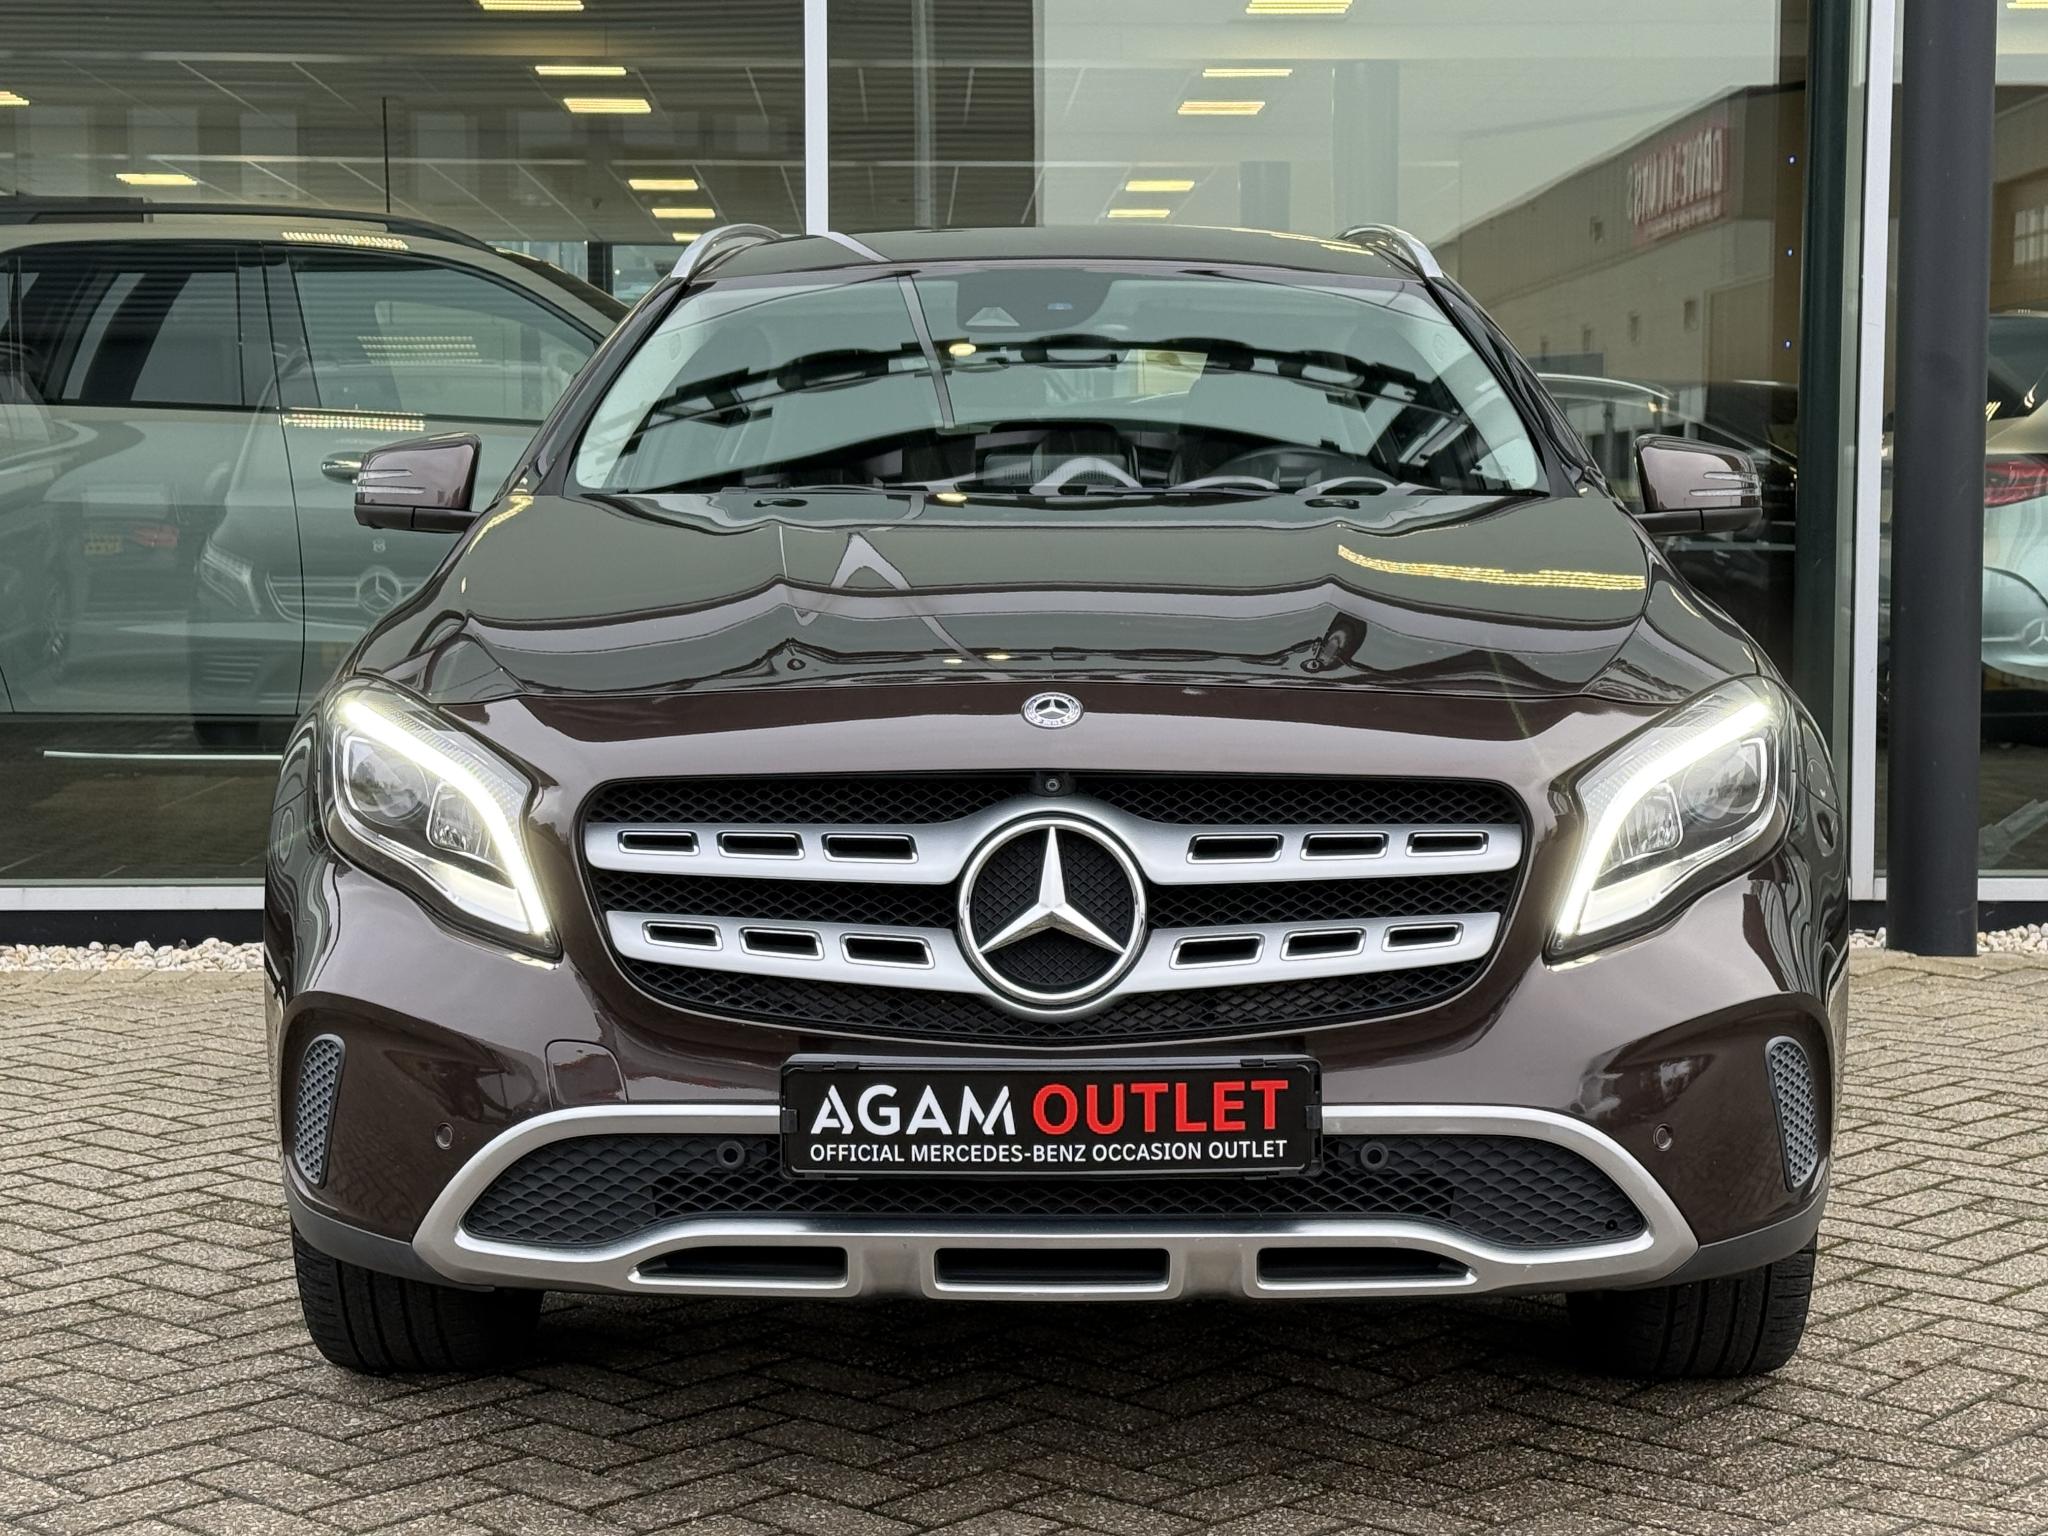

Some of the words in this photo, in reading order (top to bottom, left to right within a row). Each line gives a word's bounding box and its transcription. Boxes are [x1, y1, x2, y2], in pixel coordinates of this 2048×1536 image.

[810, 1084, 1016, 1136] AGAM
[1032, 1080, 1289, 1136] OUTLET
[809, 1143, 905, 1162] OFFICIAL
[911, 1144, 1087, 1163] MERCEDES-BENZ
[1092, 1142, 1202, 1162] OCCASION
[1208, 1140, 1288, 1160] OUTLET
